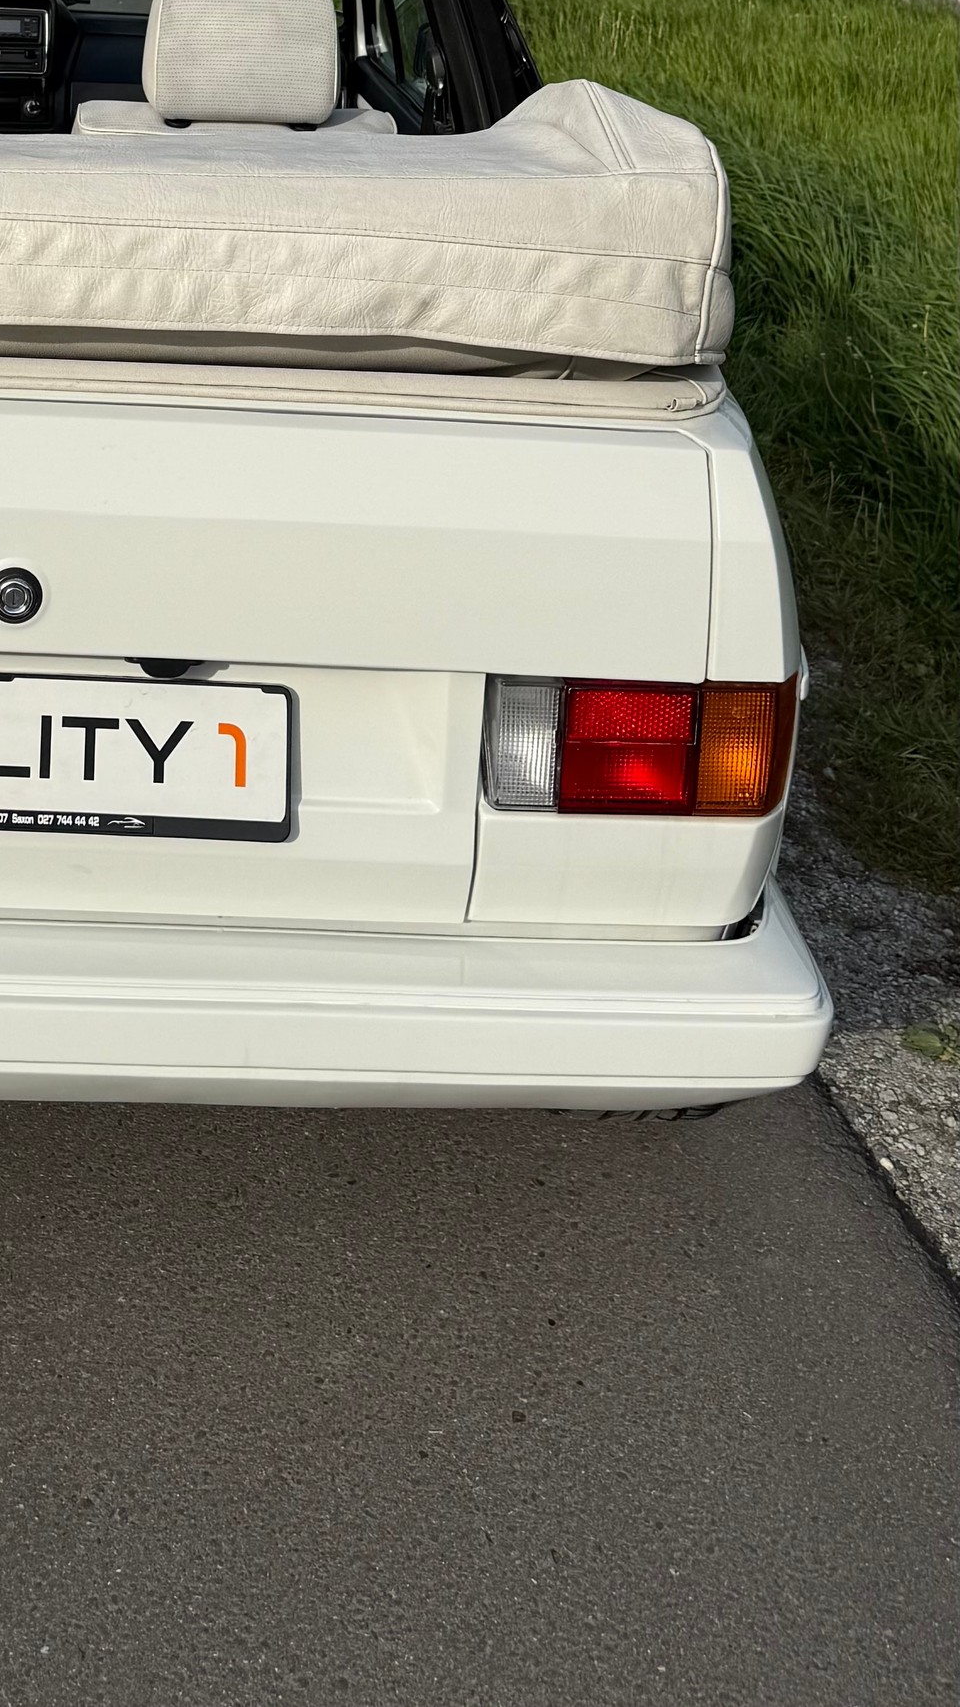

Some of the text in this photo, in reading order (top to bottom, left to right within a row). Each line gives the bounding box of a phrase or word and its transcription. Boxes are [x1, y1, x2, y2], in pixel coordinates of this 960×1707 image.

[218, 723, 246, 788] 1
[37, 814, 54, 825] 027
[56, 815, 73, 825] 744
[74, 815, 86, 826] 44
[88, 816, 100, 827] 42
